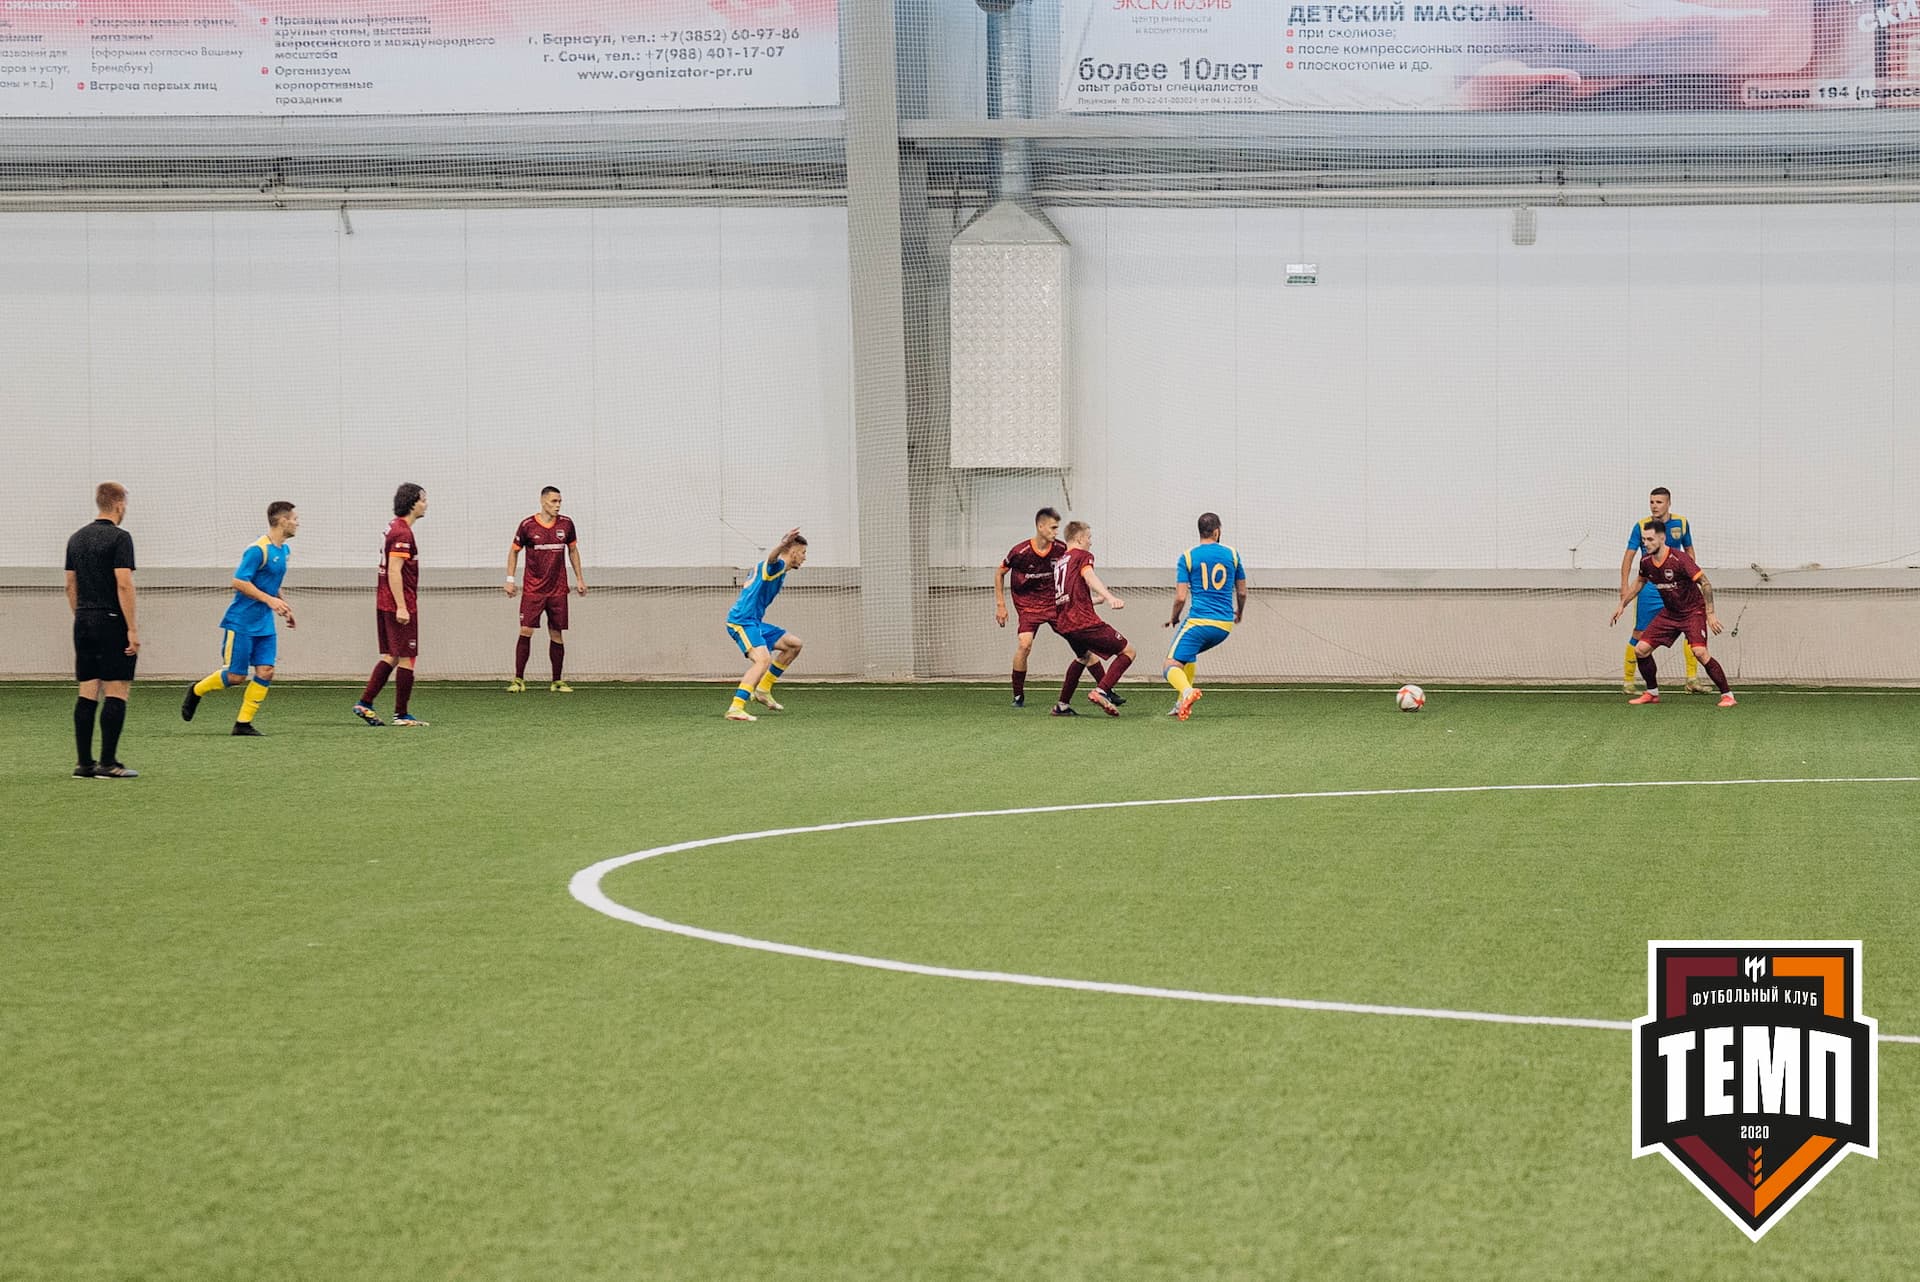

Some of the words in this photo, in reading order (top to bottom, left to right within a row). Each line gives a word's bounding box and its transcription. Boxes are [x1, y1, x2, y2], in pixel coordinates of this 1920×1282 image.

[1287, 1, 1404, 25] ДЕТСКИЙ
[1414, 4, 1534, 23] МАССАЖ:
[542, 32, 617, 47] Барнаул,
[660, 29, 728, 44] +7(3852)
[731, 27, 800, 41] 60-97-86
[1298, 28, 1324, 40] при
[1328, 28, 1397, 39] сколиозе;
[274, 50, 339, 60] масштаба
[543, 54, 555, 63] г.
[558, 51, 601, 64] Сочи,
[604, 50, 641, 62] тел.:
[706, 45, 785, 59] 401-17-07
[1298, 44, 1339, 55] после
[1343, 43, 1463, 56] компрессионных
[274, 66, 351, 78] Организуем
[1078, 57, 1168, 81] более
[1179, 57, 1263, 81] 10лет
[1298, 59, 1396, 71] плоскостопие
[1399, 60, 1408, 70] и
[1411, 60, 1433, 72] др.
[577, 66, 753, 81] www.organizator-pr.ru
[90, 80, 140, 92] Встреча
[143, 82, 190, 92] первых
[192, 81, 218, 91] лиц
[274, 80, 374, 92] корпоративные
[1077, 82, 1109, 93] опыт
[1114, 82, 1162, 94] работы
[1166, 83, 1258, 94] специалистов
[275, 95, 343, 106] праздники
[1200, 561, 1228, 591] 10
